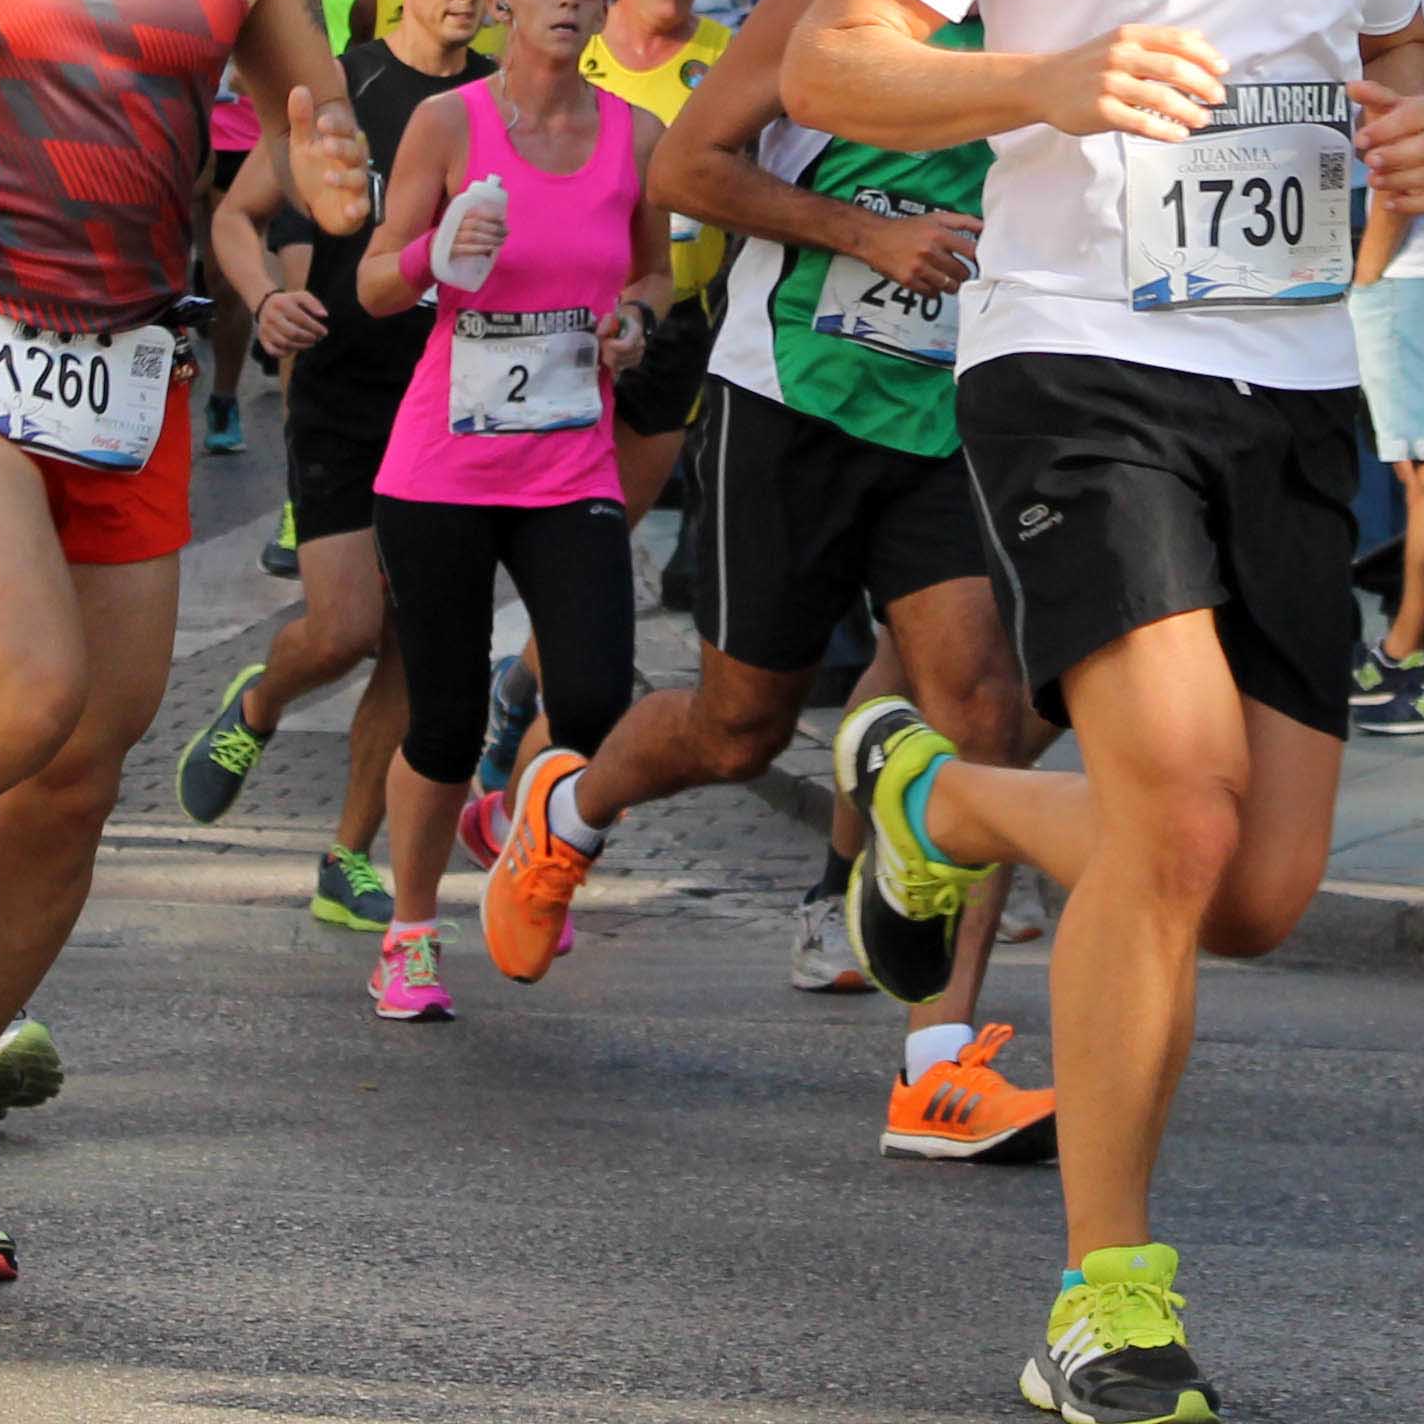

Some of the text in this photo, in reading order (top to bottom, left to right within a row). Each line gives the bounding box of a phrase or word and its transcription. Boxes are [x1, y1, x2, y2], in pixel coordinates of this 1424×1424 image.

[1237, 84, 1348, 126] MARBELLA
[1162, 176, 1304, 249] 1730
[507, 364, 530, 403] 2
